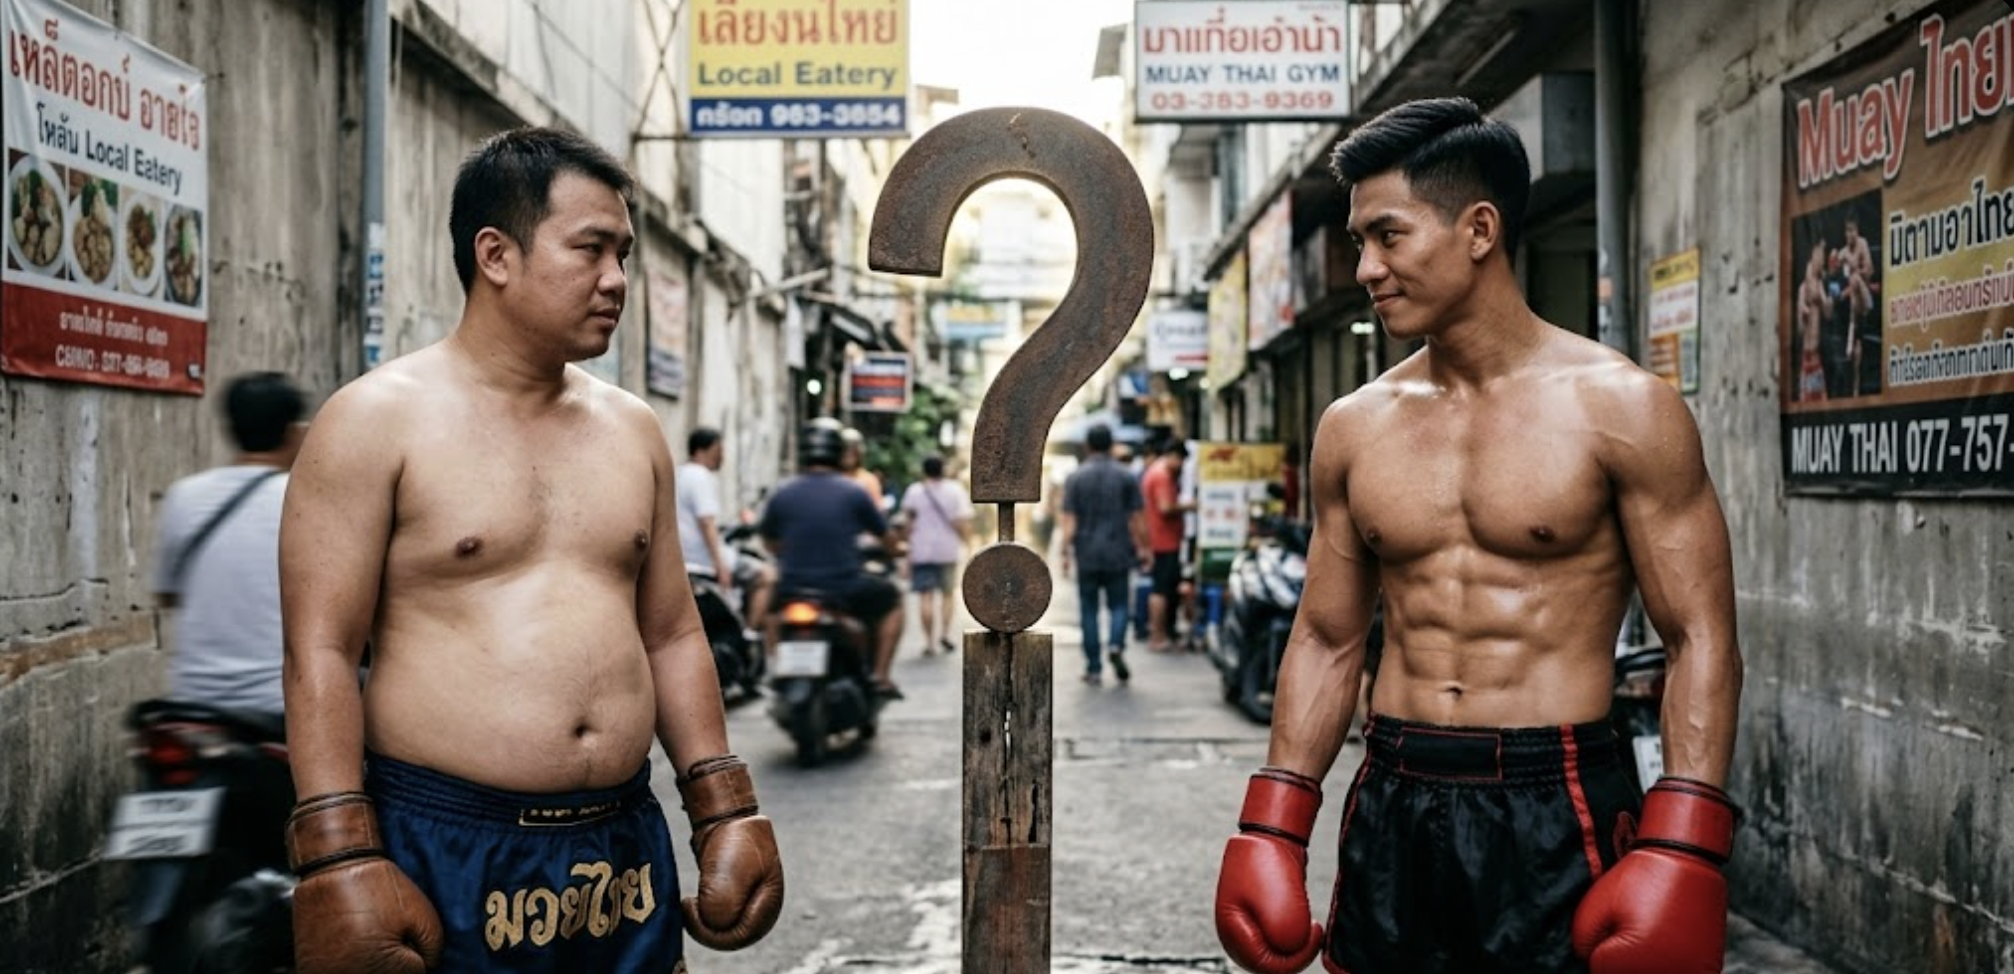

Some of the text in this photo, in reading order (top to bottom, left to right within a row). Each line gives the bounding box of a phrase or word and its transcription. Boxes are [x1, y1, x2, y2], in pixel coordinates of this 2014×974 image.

[698, 61, 896, 91] Local Eatery
[1144, 64, 1340, 84] MUAY THAI GYM
[1797, 67, 1915, 188] Muay
[85, 128, 129, 172] Local
[134, 146, 183, 197] Eatery
[1791, 423, 1845, 474] MUAY
[1849, 420, 1899, 473] THAI
